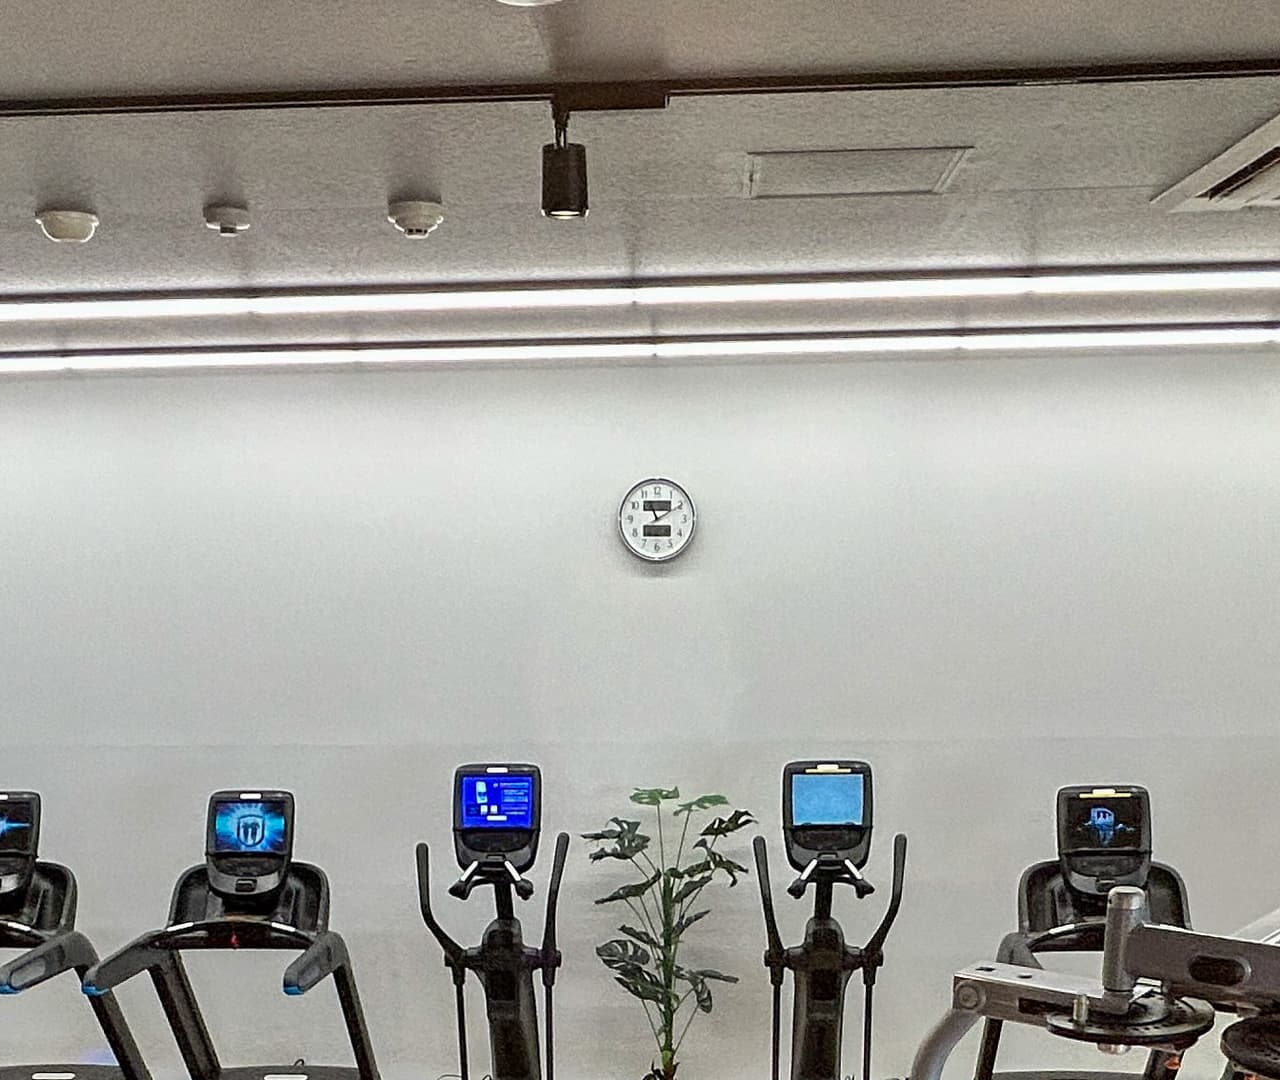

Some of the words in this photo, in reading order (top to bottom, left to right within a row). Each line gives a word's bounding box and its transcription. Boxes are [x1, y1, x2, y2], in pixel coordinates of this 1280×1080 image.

[641, 490, 648, 499] 11
[654, 486, 661, 495] 12
[631, 501, 639, 510] 10
[627, 515, 634, 524] 9
[682, 514, 687, 523] 3
[632, 528, 638, 537] 8
[676, 528, 683, 537] 4
[641, 538, 647, 549] 7
[654, 543, 661, 552] 6
[667, 539, 673, 549] 5
